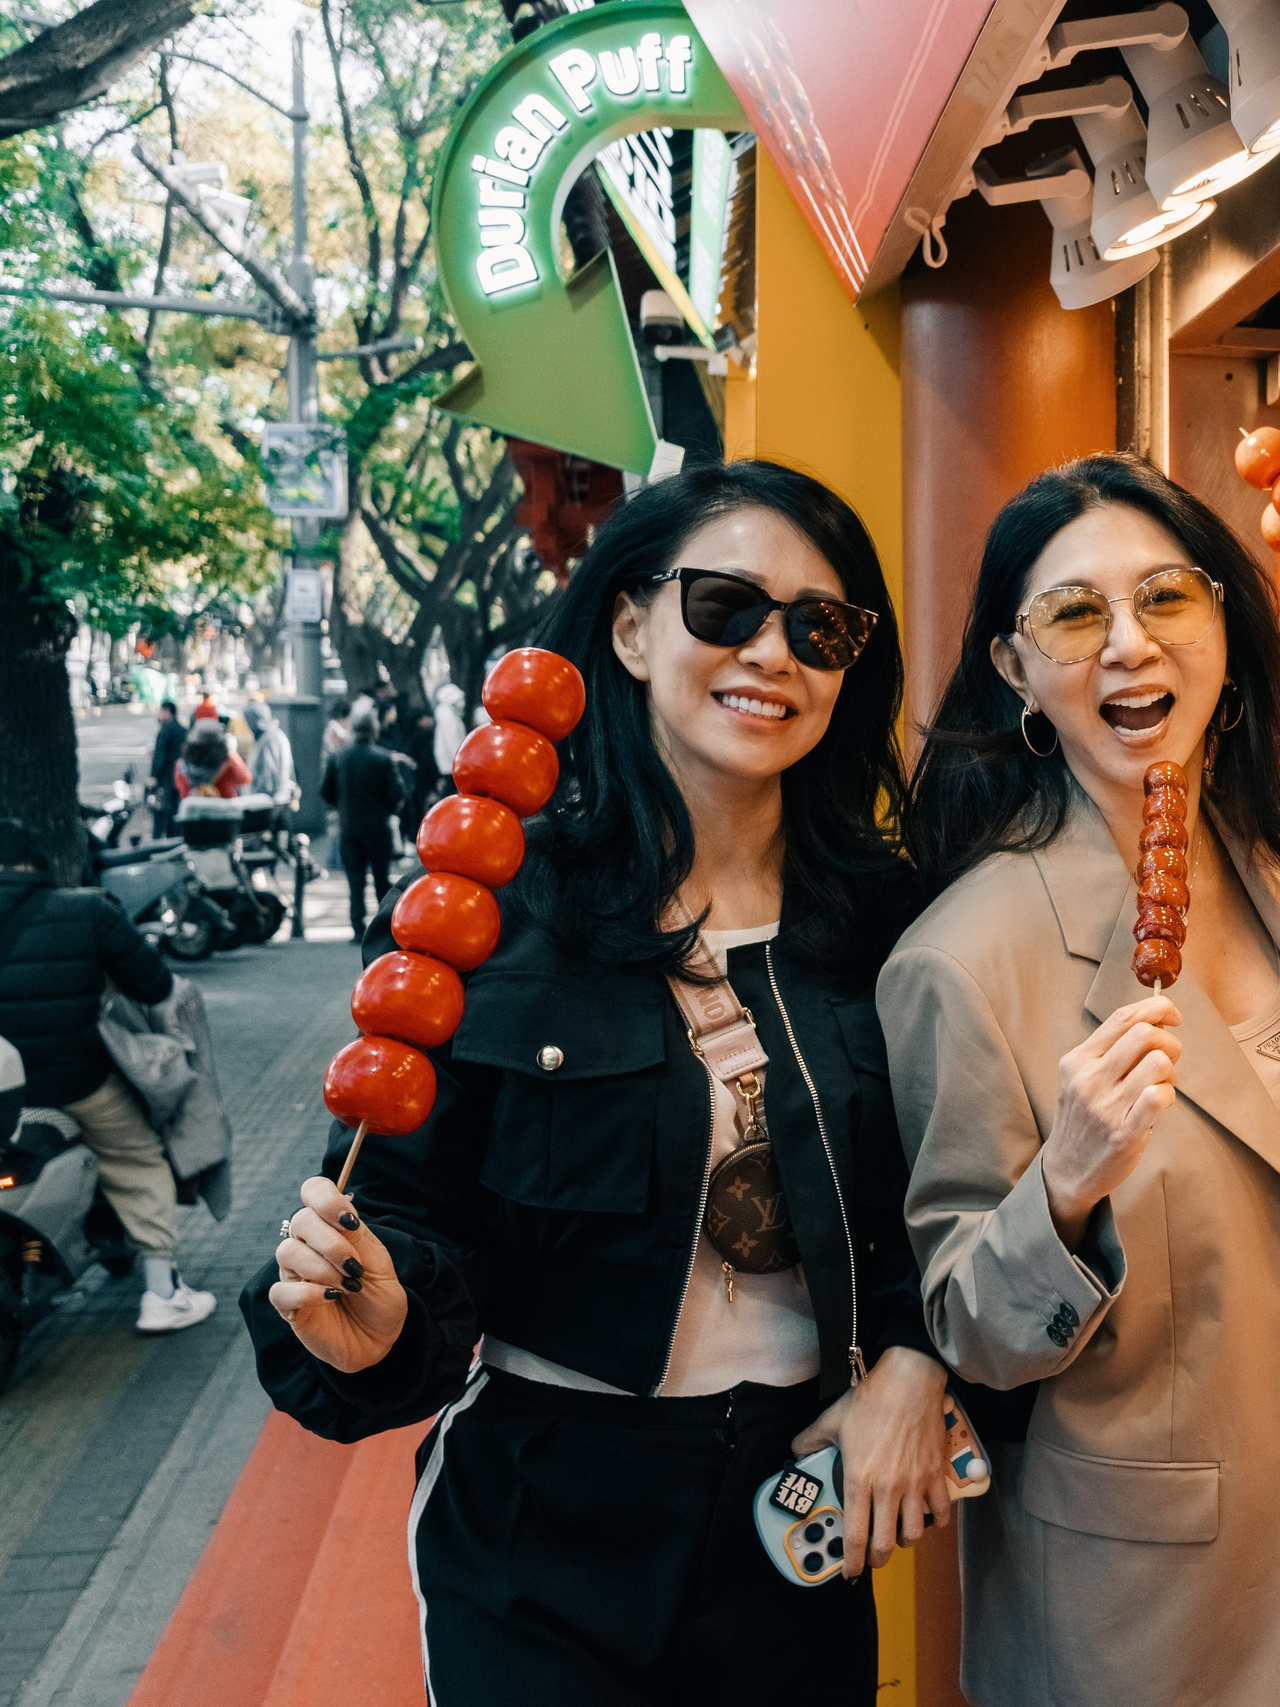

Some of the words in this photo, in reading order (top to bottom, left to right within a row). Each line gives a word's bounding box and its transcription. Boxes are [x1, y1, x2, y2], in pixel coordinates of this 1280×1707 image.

[471, 94, 570, 296] Durian
[549, 33, 692, 112] Puff
[776, 1485, 813, 1514] BYE
[782, 1473, 819, 1501] BYE
